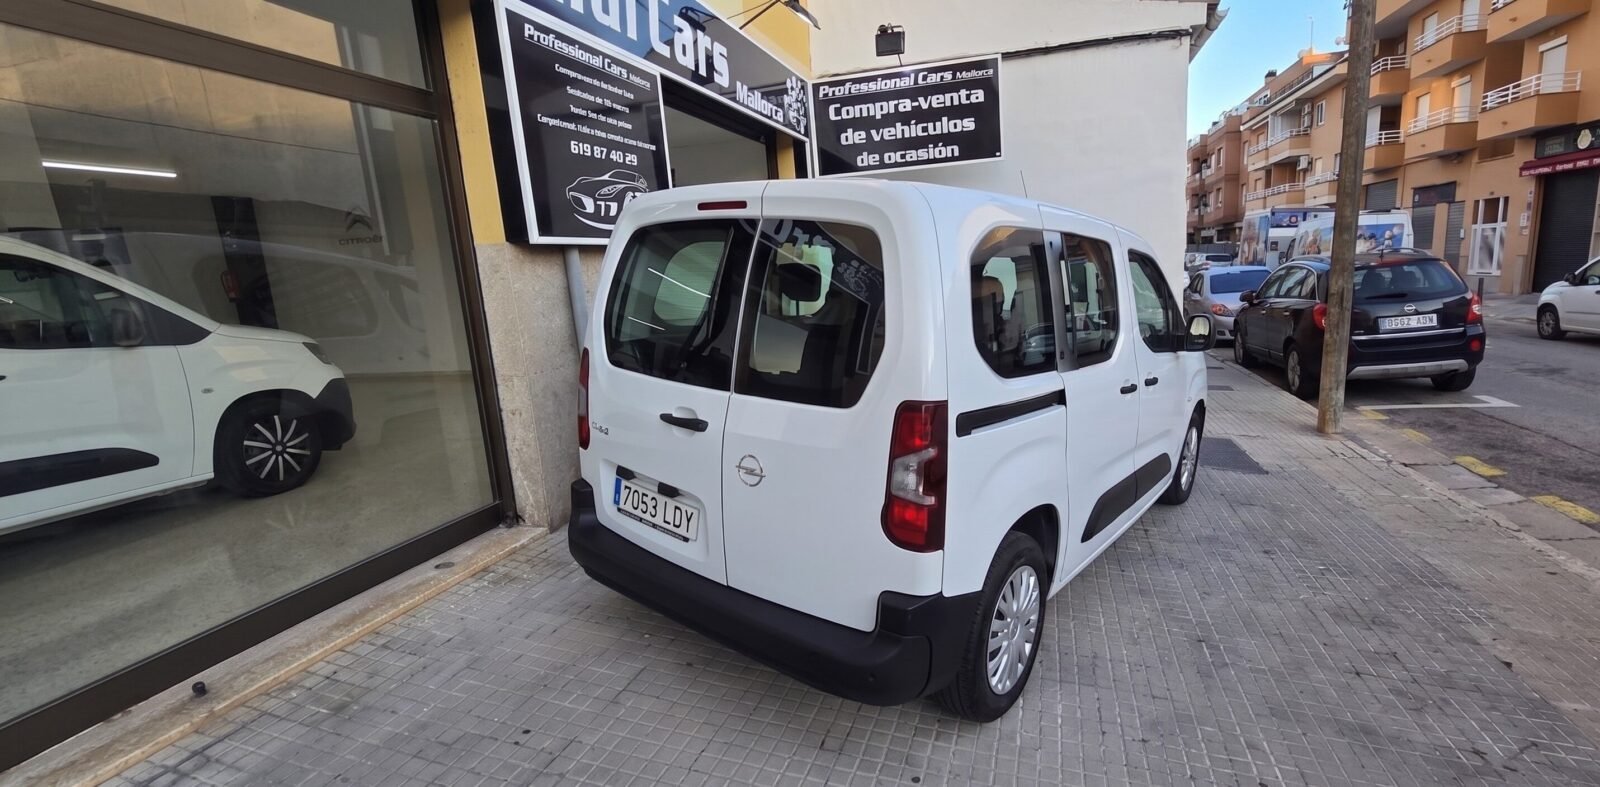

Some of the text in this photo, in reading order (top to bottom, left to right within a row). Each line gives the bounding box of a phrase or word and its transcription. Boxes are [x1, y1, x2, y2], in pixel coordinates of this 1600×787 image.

[524, 23, 603, 69] Professional
[604, 57, 628, 79] Cars
[650, 0, 730, 88] Cars
[735, 80, 784, 123] Mallorca
[819, 68, 994, 98] Professional Cars Mallorca
[829, 88, 985, 121] Compra-venta
[840, 116, 976, 145] de vehículos
[570, 140, 638, 166] 619 87 40 29
[856, 142, 959, 167] de ocasión
[623, 485, 658, 518] 7053
[663, 500, 694, 533] LDY
